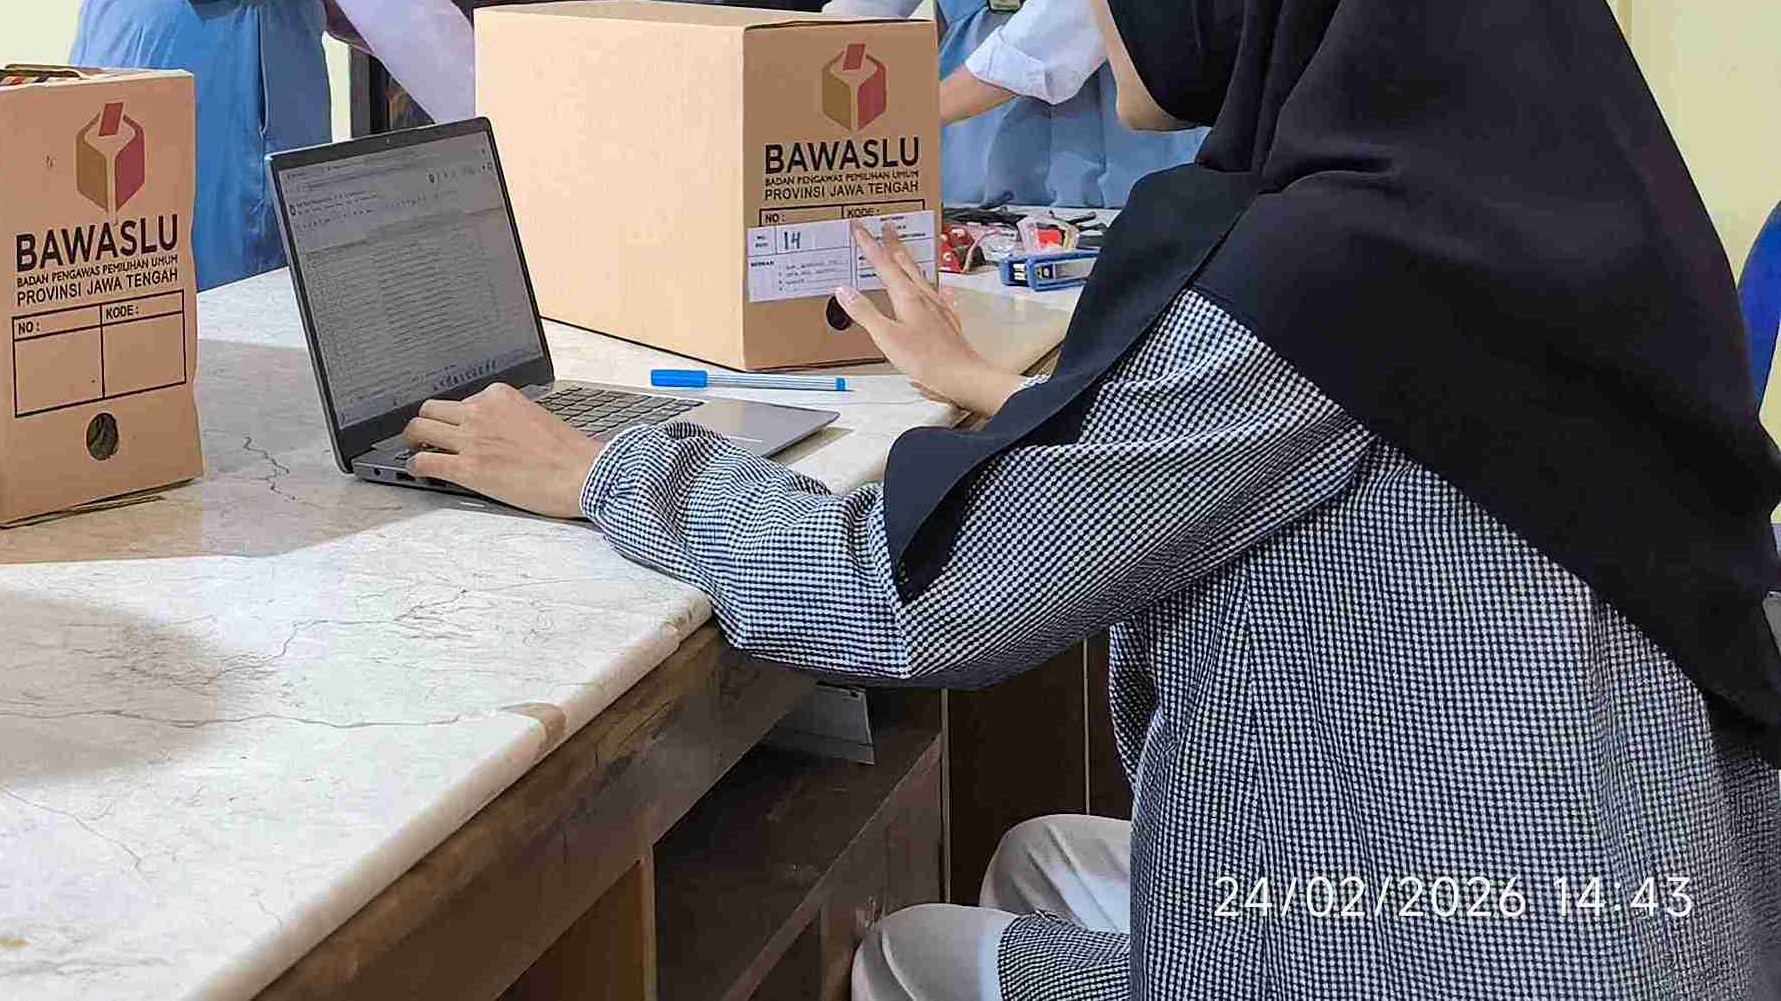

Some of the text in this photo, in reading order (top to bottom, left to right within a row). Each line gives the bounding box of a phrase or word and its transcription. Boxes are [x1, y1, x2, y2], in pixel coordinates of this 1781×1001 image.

[764, 136, 920, 175] BAWASLU
[765, 175, 795, 187] BADAN
[796, 173, 843, 185] PENGAWAS
[844, 171, 891, 182] PEMILIHAN
[764, 181, 919, 201] PROVINSI JAWA TENGAH
[765, 213, 780, 224] NO
[16, 213, 179, 273] BAWASLU
[17, 254, 178, 289] BADAN PENGAWAS PEMILIHAN UMUM
[17, 268, 178, 307] PROVINSI JAWA TENGAH
[105, 304, 134, 320] KODE
[18, 321, 35, 336] NO
